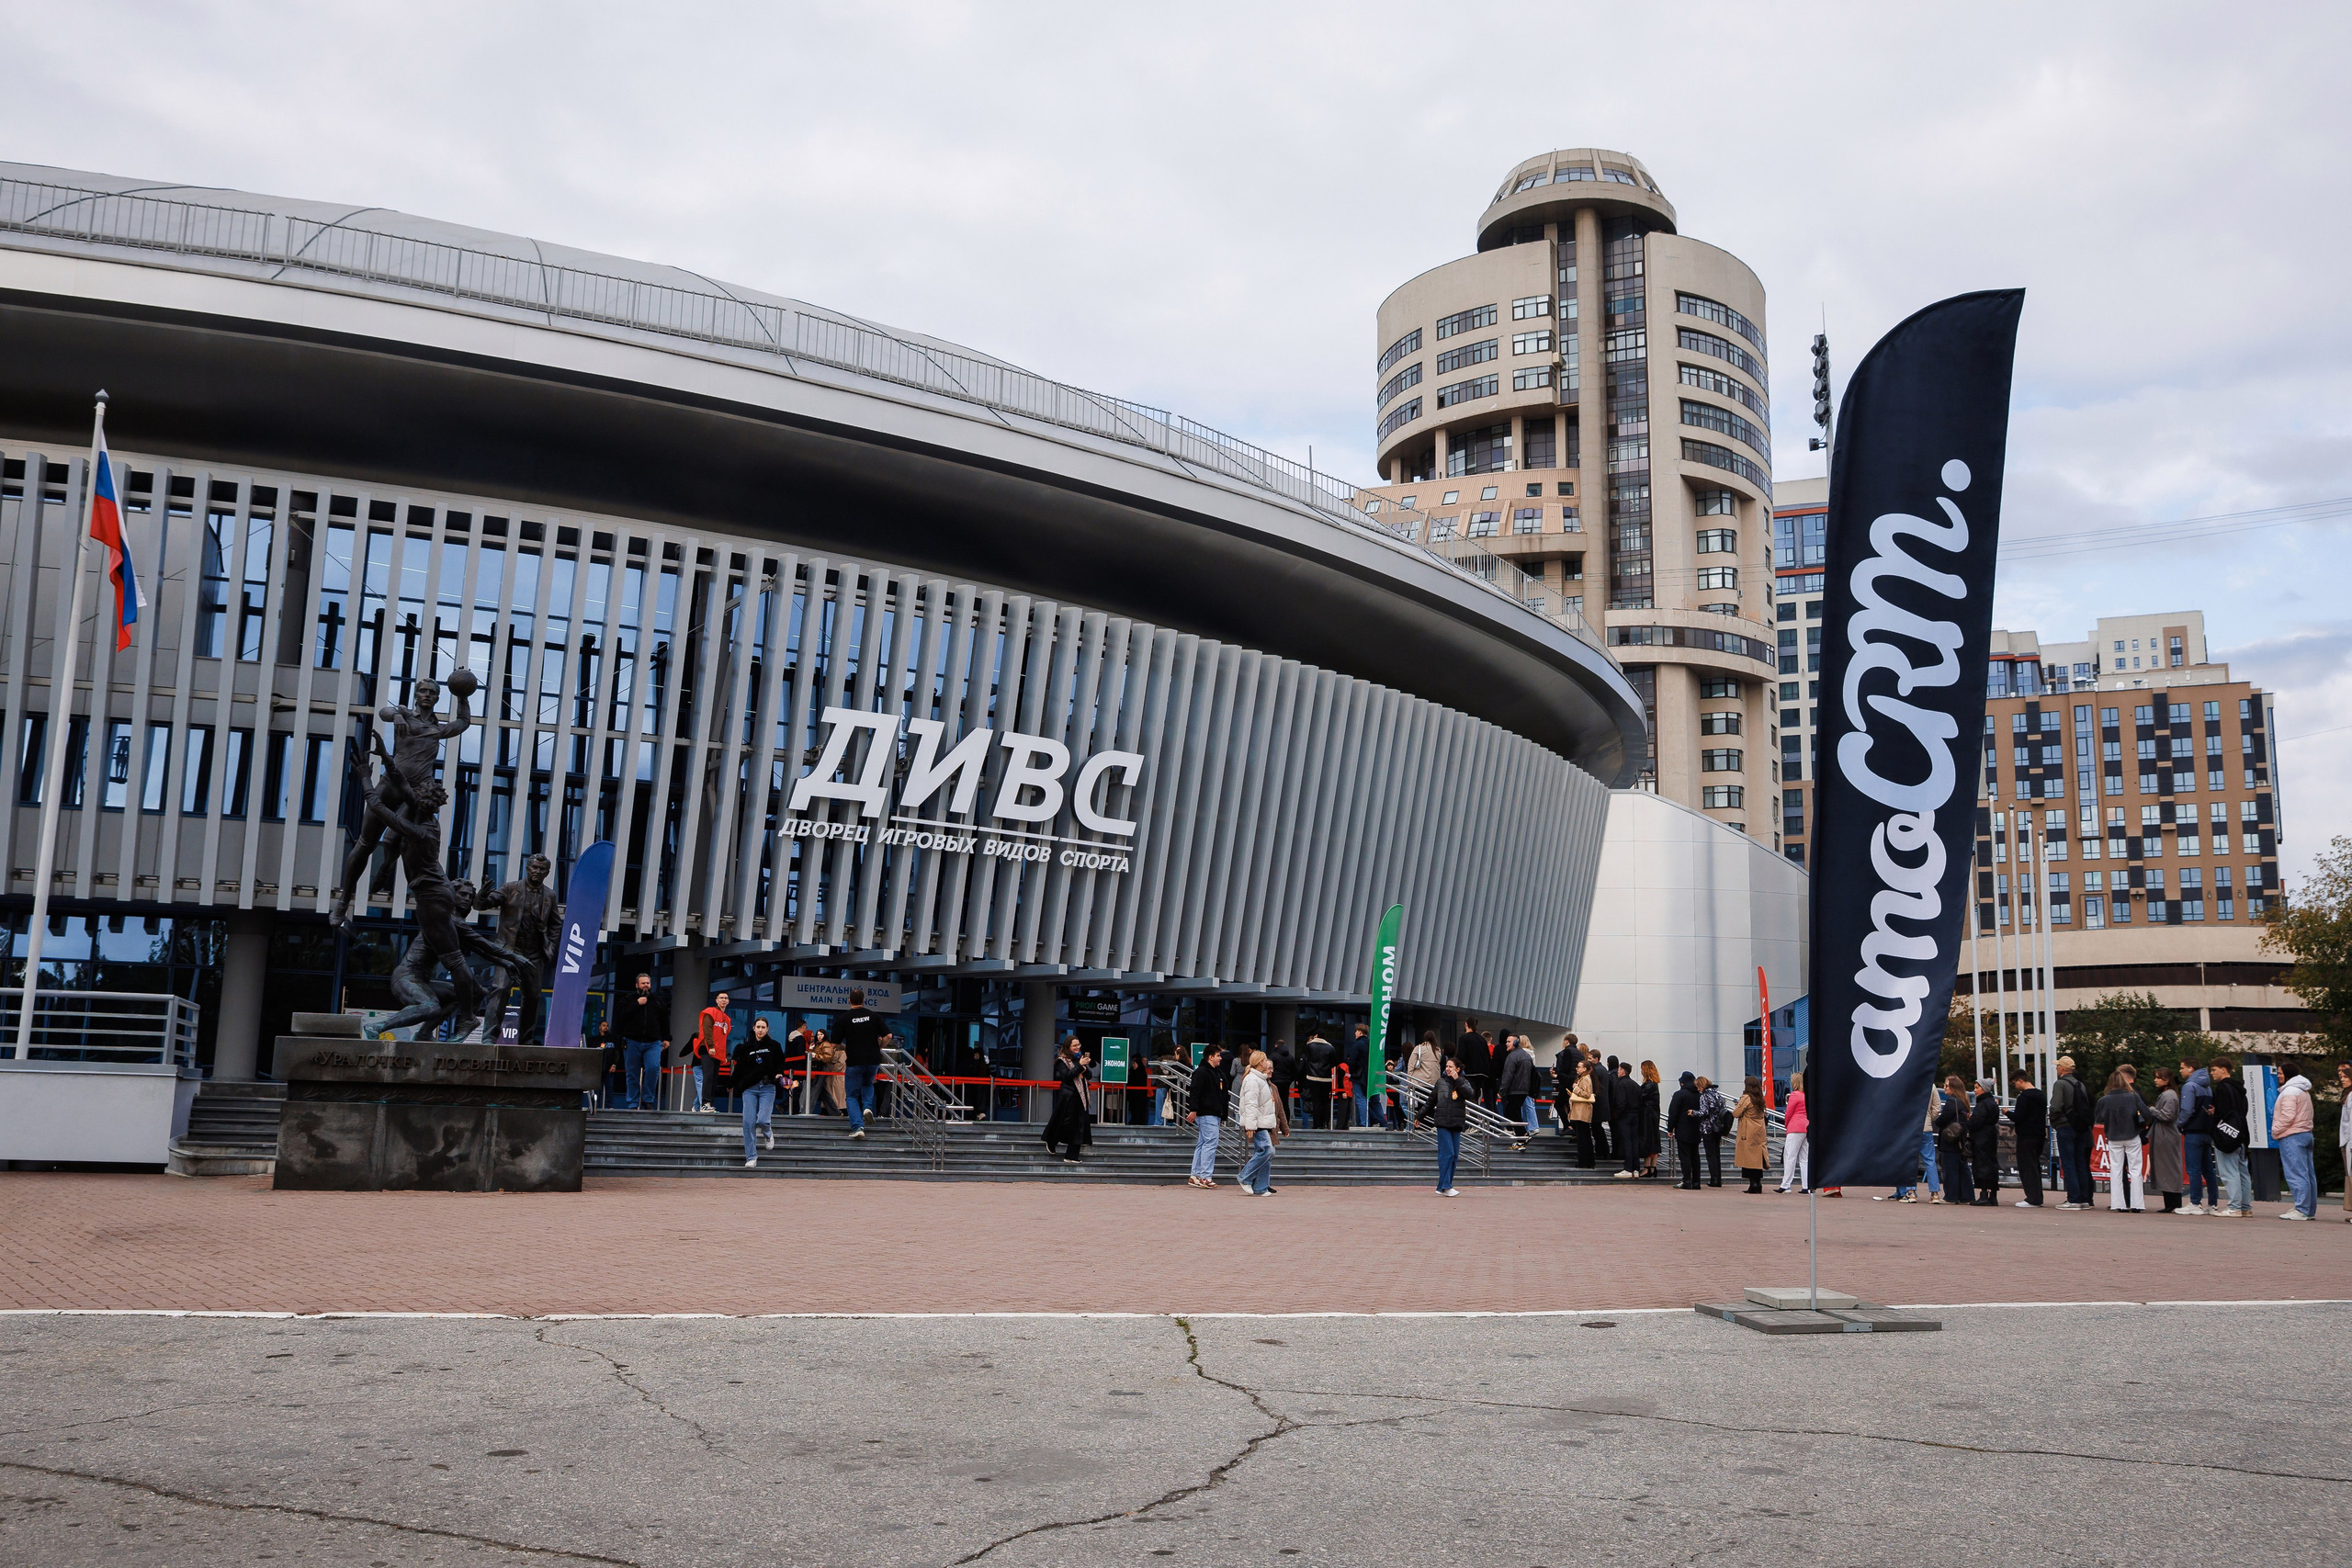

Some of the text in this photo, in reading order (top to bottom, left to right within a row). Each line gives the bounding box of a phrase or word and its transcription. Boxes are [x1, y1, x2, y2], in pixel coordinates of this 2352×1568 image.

[787, 706, 1145, 836] ДИВС
[778, 818, 1130, 873] ДВОРЕЦ ИГРОВЫХ ВИДОВ СПОРТА
[561, 923, 585, 974] VIP
[868, 988, 889, 997] ВХОД
[838, 997, 877, 1007] ENNCE
[1075, 1001, 1118, 1011] PROFI GAME
[503, 1028, 518, 1039] VIP
[1104, 1059, 1125, 1067] ЭКОНОМ
[2217, 1119, 2240, 1139] VANS
